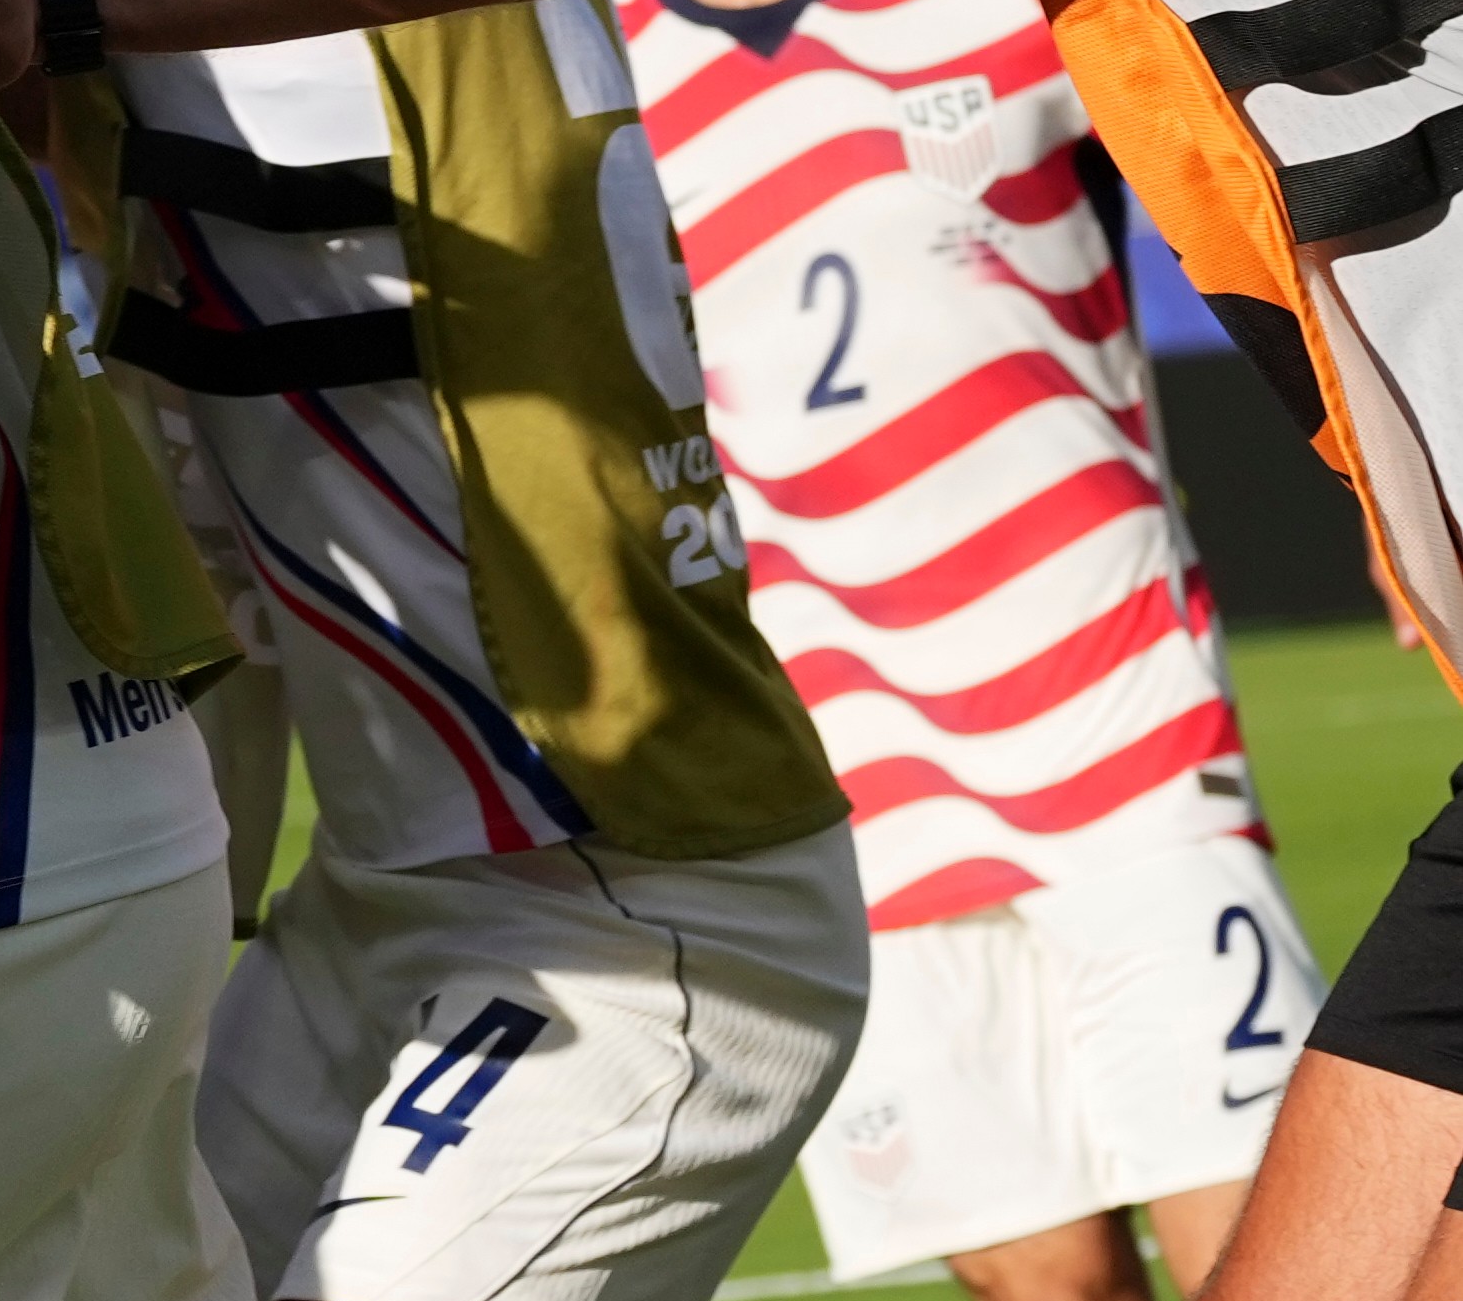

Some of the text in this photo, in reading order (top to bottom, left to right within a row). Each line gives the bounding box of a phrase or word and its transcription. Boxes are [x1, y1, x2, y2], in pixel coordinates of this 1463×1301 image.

[904, 85, 985, 134] USA
[801, 252, 870, 414] 2
[1217, 906, 1282, 1050] 2
[380, 994, 551, 1175] 4
